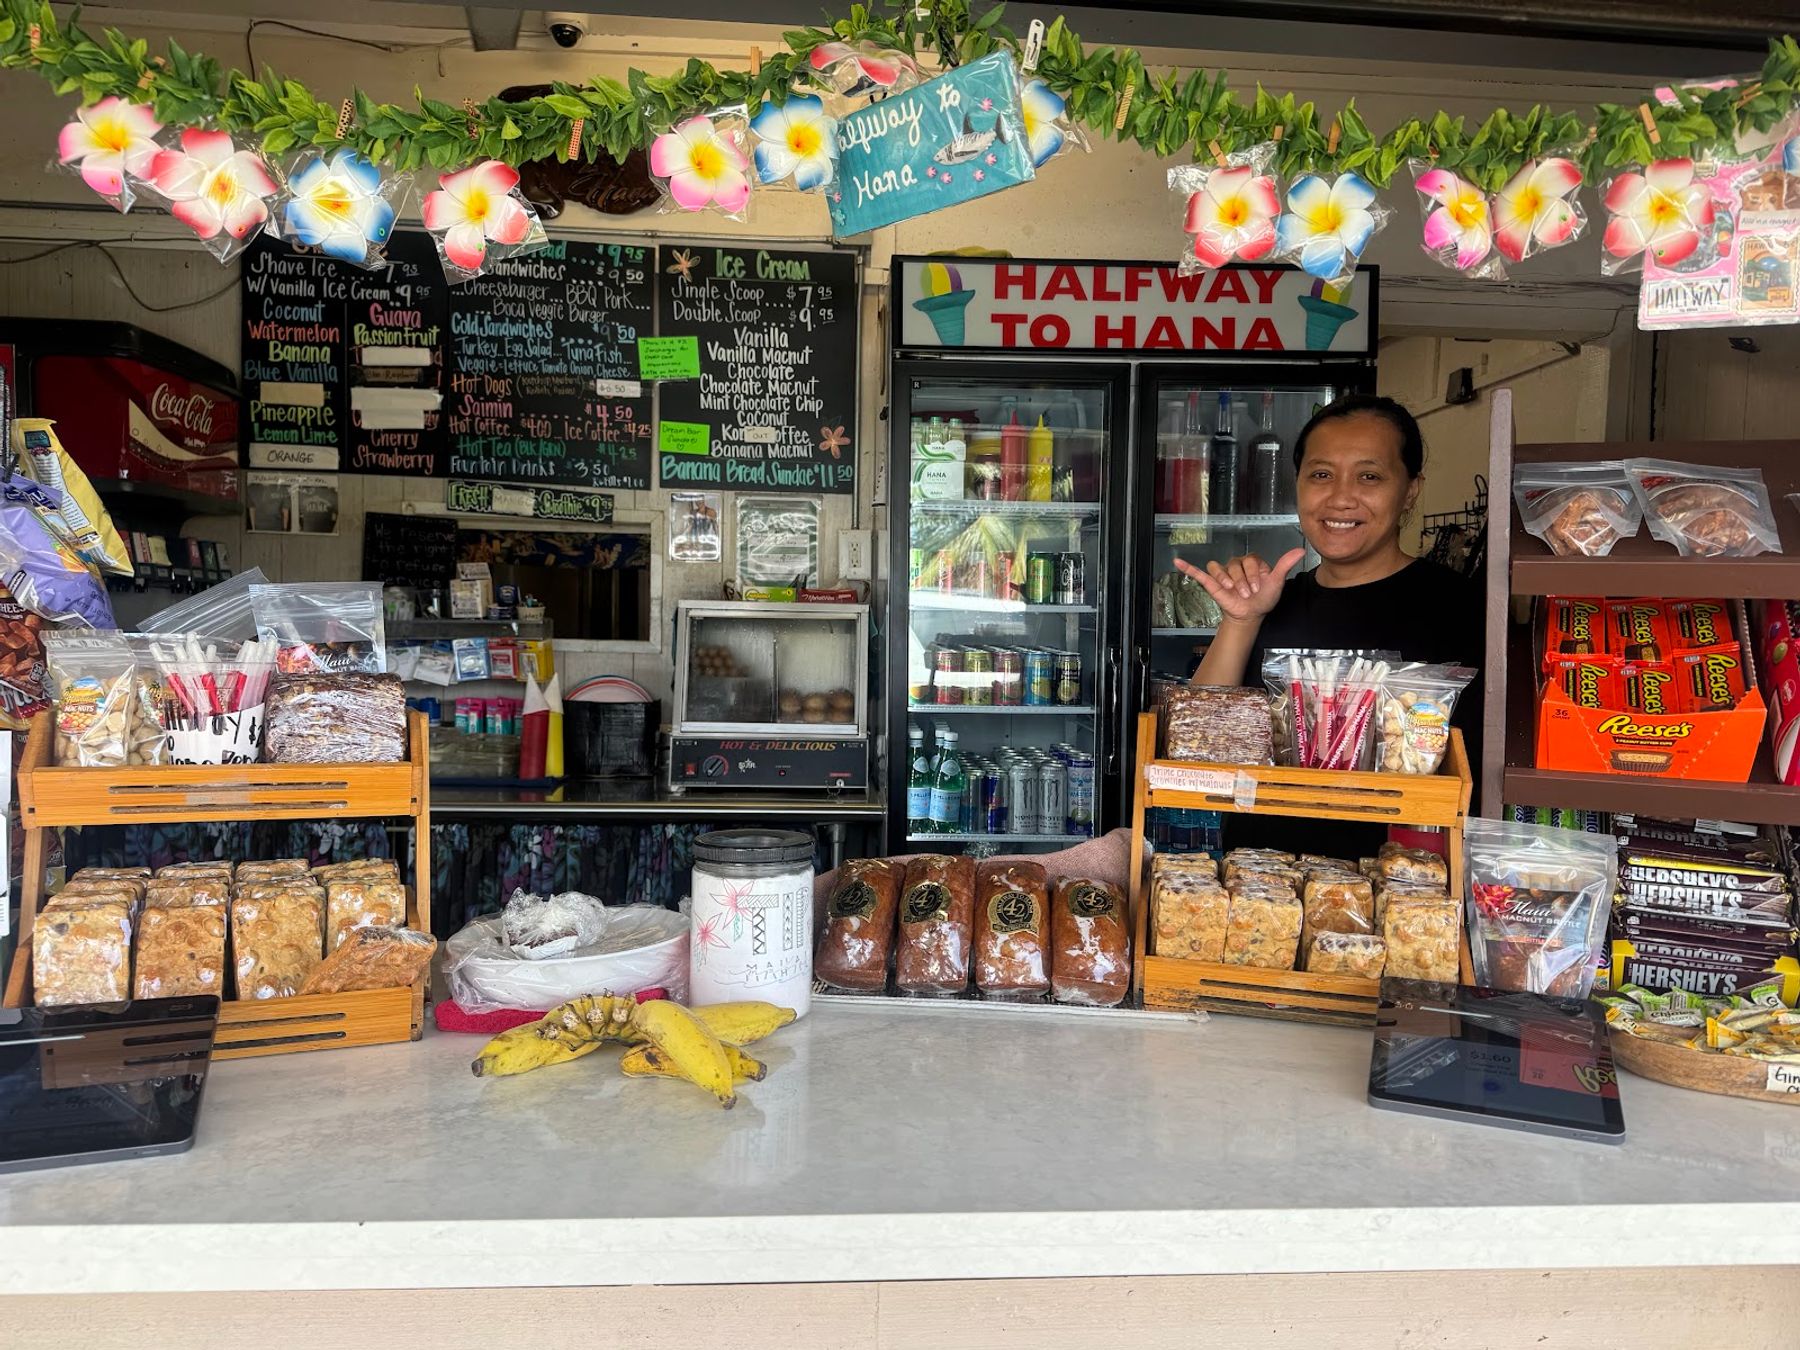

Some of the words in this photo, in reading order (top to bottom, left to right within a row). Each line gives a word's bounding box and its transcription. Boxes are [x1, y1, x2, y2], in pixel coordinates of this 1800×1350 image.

[839, 97, 924, 154] alfway
[936, 83, 961, 112] to
[853, 164, 918, 208] Hana
[251, 251, 307, 276] Shave
[312, 258, 338, 277] Ice
[715, 249, 746, 278] Ice
[756, 250, 812, 281] Cream
[323, 277, 348, 299] Ice
[351, 281, 391, 301] Cream
[566, 283, 599, 308] BBQ
[671, 276, 721, 308] Single
[724, 279, 765, 306] Scoop
[993, 263, 1286, 304] HALFWAY
[263, 297, 326, 322] Coconut
[369, 302, 422, 328] Guava
[493, 299, 526, 318] Boca
[529, 301, 565, 321] Veggie
[568, 304, 609, 325] Burger
[672, 301, 723, 323] Double
[725, 302, 761, 325] Scoop
[248, 320, 340, 344] Watermelon
[734, 326, 789, 348] Vanilla
[990, 313, 1072, 349] TO
[1094, 315, 1286, 351] HANA
[268, 340, 331, 364] Banana
[504, 337, 524, 358] Egg
[706, 341, 756, 363] Vanilla
[762, 345, 814, 365] Macnut
[244, 360, 281, 381] Blue
[286, 362, 339, 383] Vanilla
[727, 364, 795, 381] Chocolate
[451, 374, 483, 395] Hot
[484, 377, 513, 398] Dogs
[700, 373, 764, 395] Chocolate
[767, 376, 820, 396] Macnut
[151, 382, 215, 436] Coca-Cola
[250, 401, 337, 427] Pineapple
[458, 394, 513, 419] Saimin
[700, 393, 731, 411] Mint
[733, 393, 791, 412] Chocolate
[795, 396, 824, 419] Chip
[448, 416, 474, 436] Hot
[474, 416, 511, 437] Coffee
[564, 421, 583, 440] Ice
[585, 421, 620, 442] Coffee
[737, 410, 790, 427] Coconut
[253, 423, 299, 443] Lemon
[301, 426, 339, 445] Lime
[370, 429, 419, 451] Cherry
[775, 424, 810, 444] offee
[266, 450, 316, 464] ORANGE
[457, 437, 487, 457] Hot
[490, 438, 513, 457] Tea
[711, 440, 764, 459] Banana
[768, 442, 815, 459] Macnut
[352, 445, 435, 476] Strawberry
[450, 455, 507, 475] Fountain
[511, 459, 556, 477] Drinks
[662, 456, 722, 482] Banana
[726, 460, 766, 484] Bread
[766, 461, 816, 487] Sundae
[450, 484, 488, 509] FRESH
[541, 491, 584, 517] Smoothie
[1573, 600, 1600, 641] Reese's
[1632, 604, 1660, 644] Reese's
[1692, 603, 1722, 644] Reese's
[1706, 653, 1738, 705] Reese's
[1642, 669, 1672, 715] Reese's
[1554, 708, 1569, 716] 36
[1597, 714, 1695, 739] Reese's
[719, 741, 749, 751] HOT
[764, 742, 838, 752] DELICIOUS
[914, 889, 935, 907] 42
[1003, 898, 1025, 918] 42
[1083, 891, 1105, 909] 42
[1633, 883, 1743, 909] HERSHEY'S
[1501, 914, 1543, 923] MACNUT
[1631, 963, 1738, 995] HERSHEY'S
[1650, 1008, 1696, 1019] Chimes
[1470, 1051, 1512, 1064] $1.60
